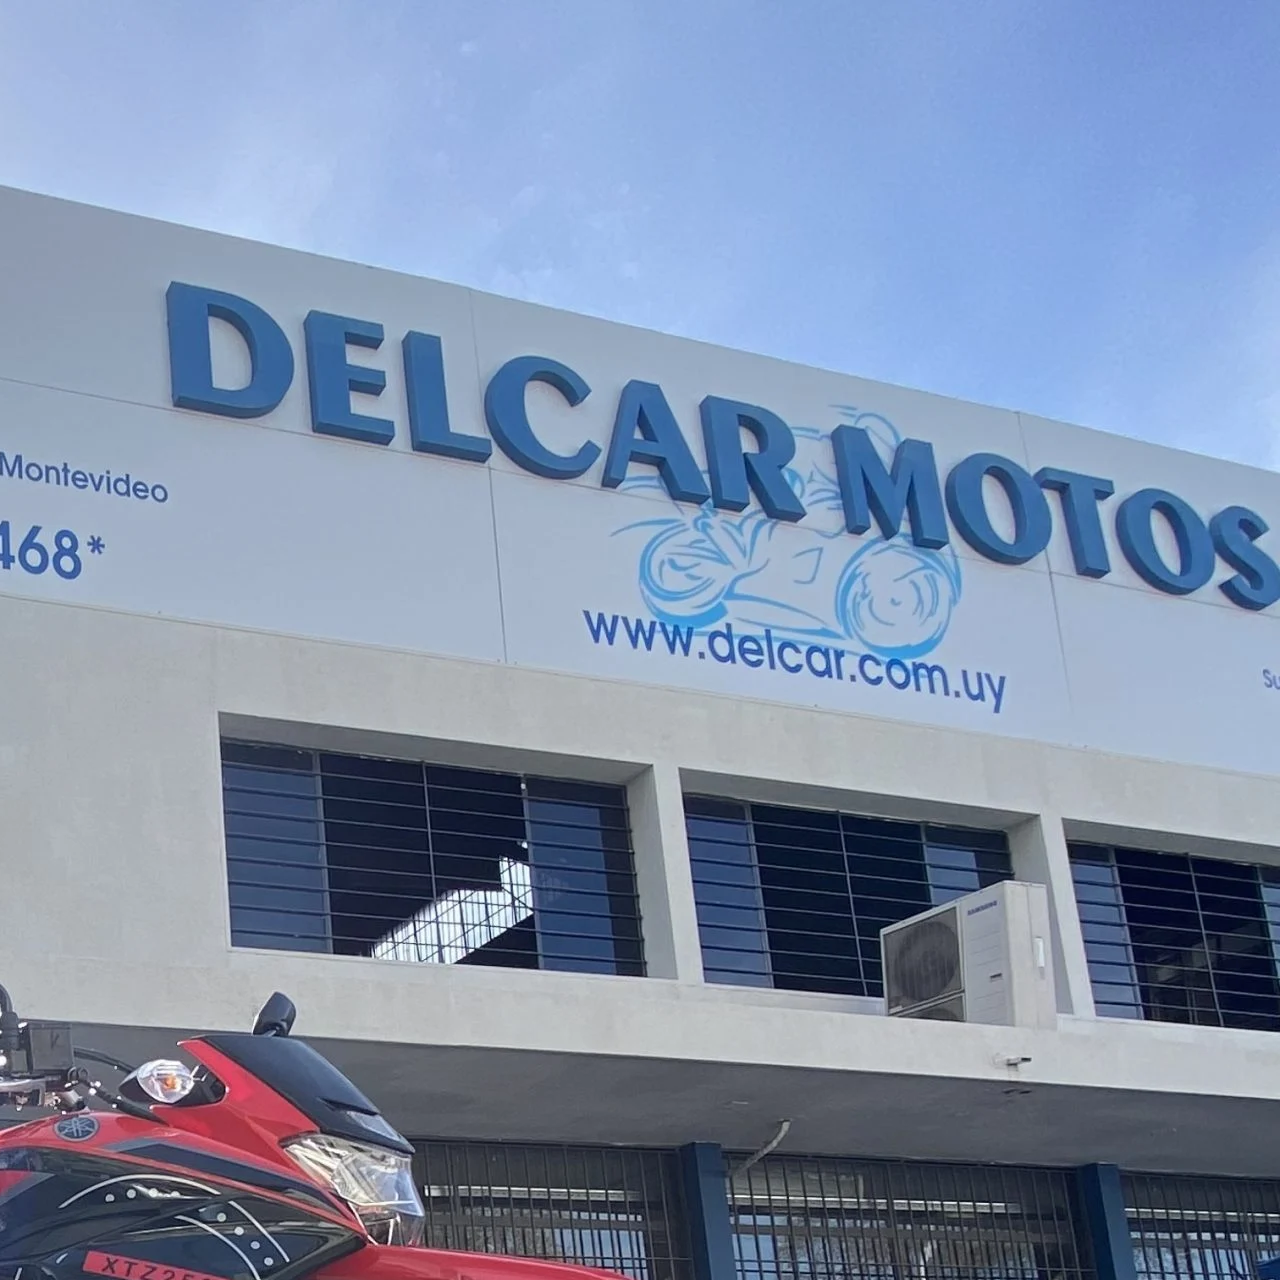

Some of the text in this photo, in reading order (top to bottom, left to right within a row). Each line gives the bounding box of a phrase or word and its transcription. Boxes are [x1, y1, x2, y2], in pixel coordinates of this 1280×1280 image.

[165, 281, 1280, 611] DELCAR MOTOS
[583, 610, 1006, 714] www.delcar.com.uy
